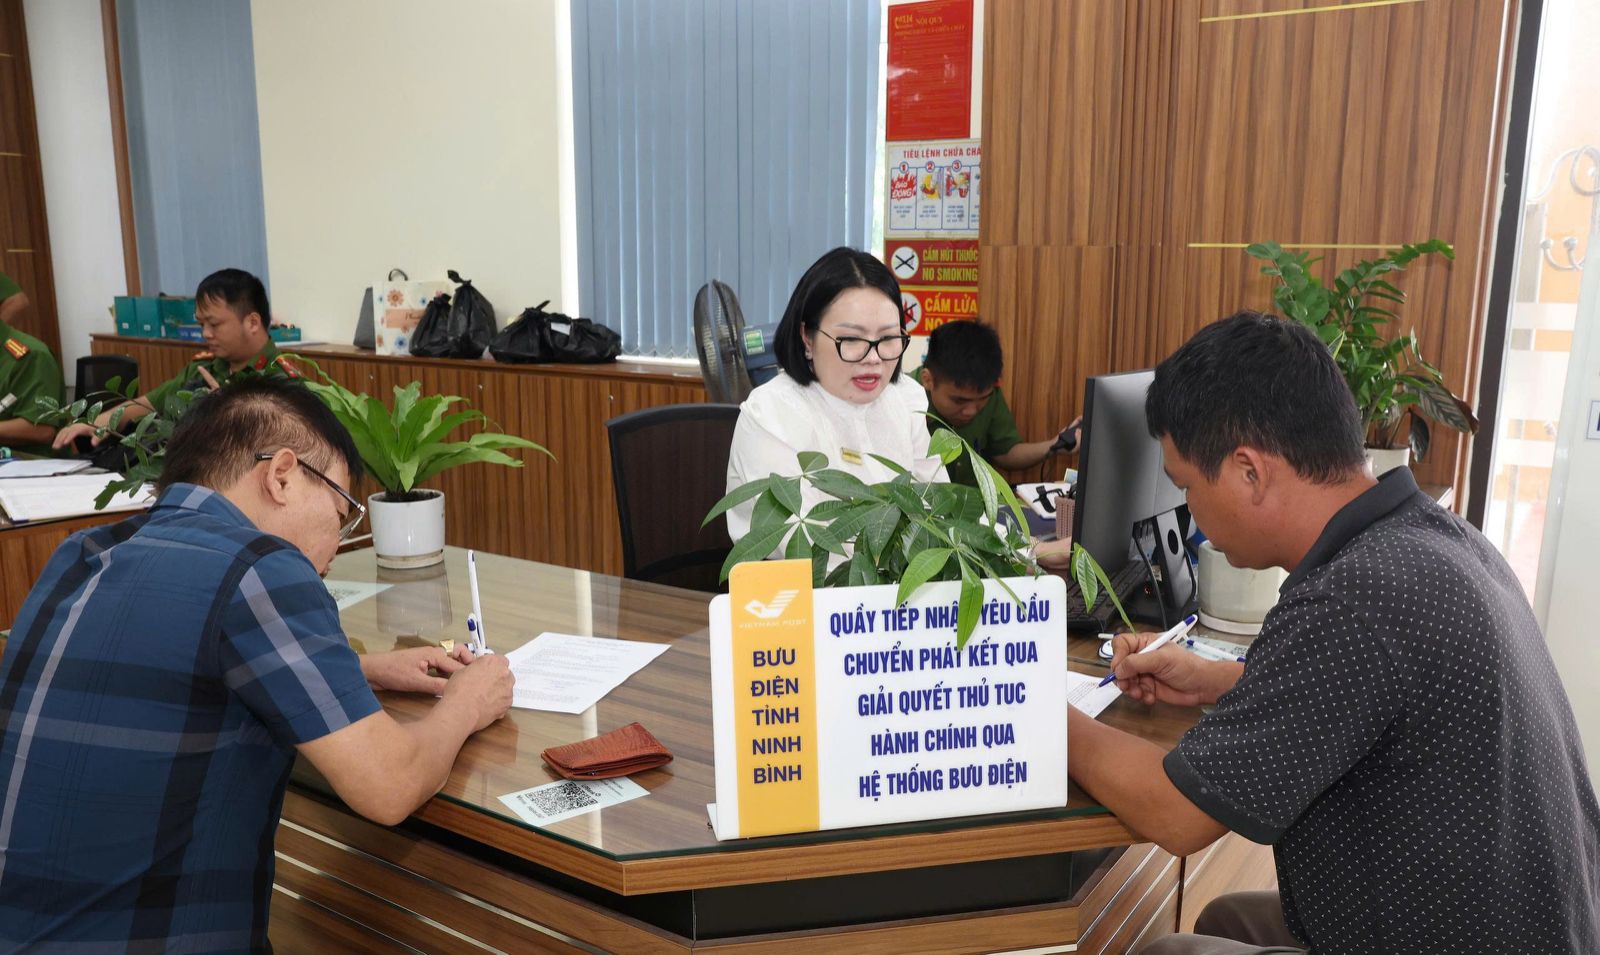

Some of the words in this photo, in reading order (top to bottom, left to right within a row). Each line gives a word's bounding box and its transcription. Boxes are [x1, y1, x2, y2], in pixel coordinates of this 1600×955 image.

[922, 267, 935, 281] NO
[937, 267, 978, 281] SMOKING
[925, 292, 951, 313] CẤM
[953, 293, 977, 313] LỬA
[830, 603, 876, 638] QUẦY
[881, 601, 919, 632] TIẾP
[925, 601, 959, 632] NHẬ
[981, 598, 1011, 626] YÊU
[1016, 593, 1050, 625] CẦU
[753, 647, 796, 668] BƯU
[844, 640, 914, 676] CHUYỂN
[919, 641, 964, 672] PHÁT
[968, 637, 999, 667] KẾT
[751, 675, 799, 698] ĐIỆN
[858, 685, 893, 717] GIẢI
[899, 681, 953, 715] QUYẾT
[957, 677, 990, 709] THỦ
[752, 704, 800, 726] TỈNH
[752, 736, 801, 755] NINH
[871, 728, 919, 756] HÀNH
[925, 723, 977, 752] CHÍNH
[982, 723, 1015, 750] QUA
[754, 764, 802, 785] BÌNH
[859, 770, 881, 801] HỆ
[886, 763, 943, 796] THỐNG
[949, 765, 982, 790] BƯU
[988, 758, 1027, 788] ĐIỆN
